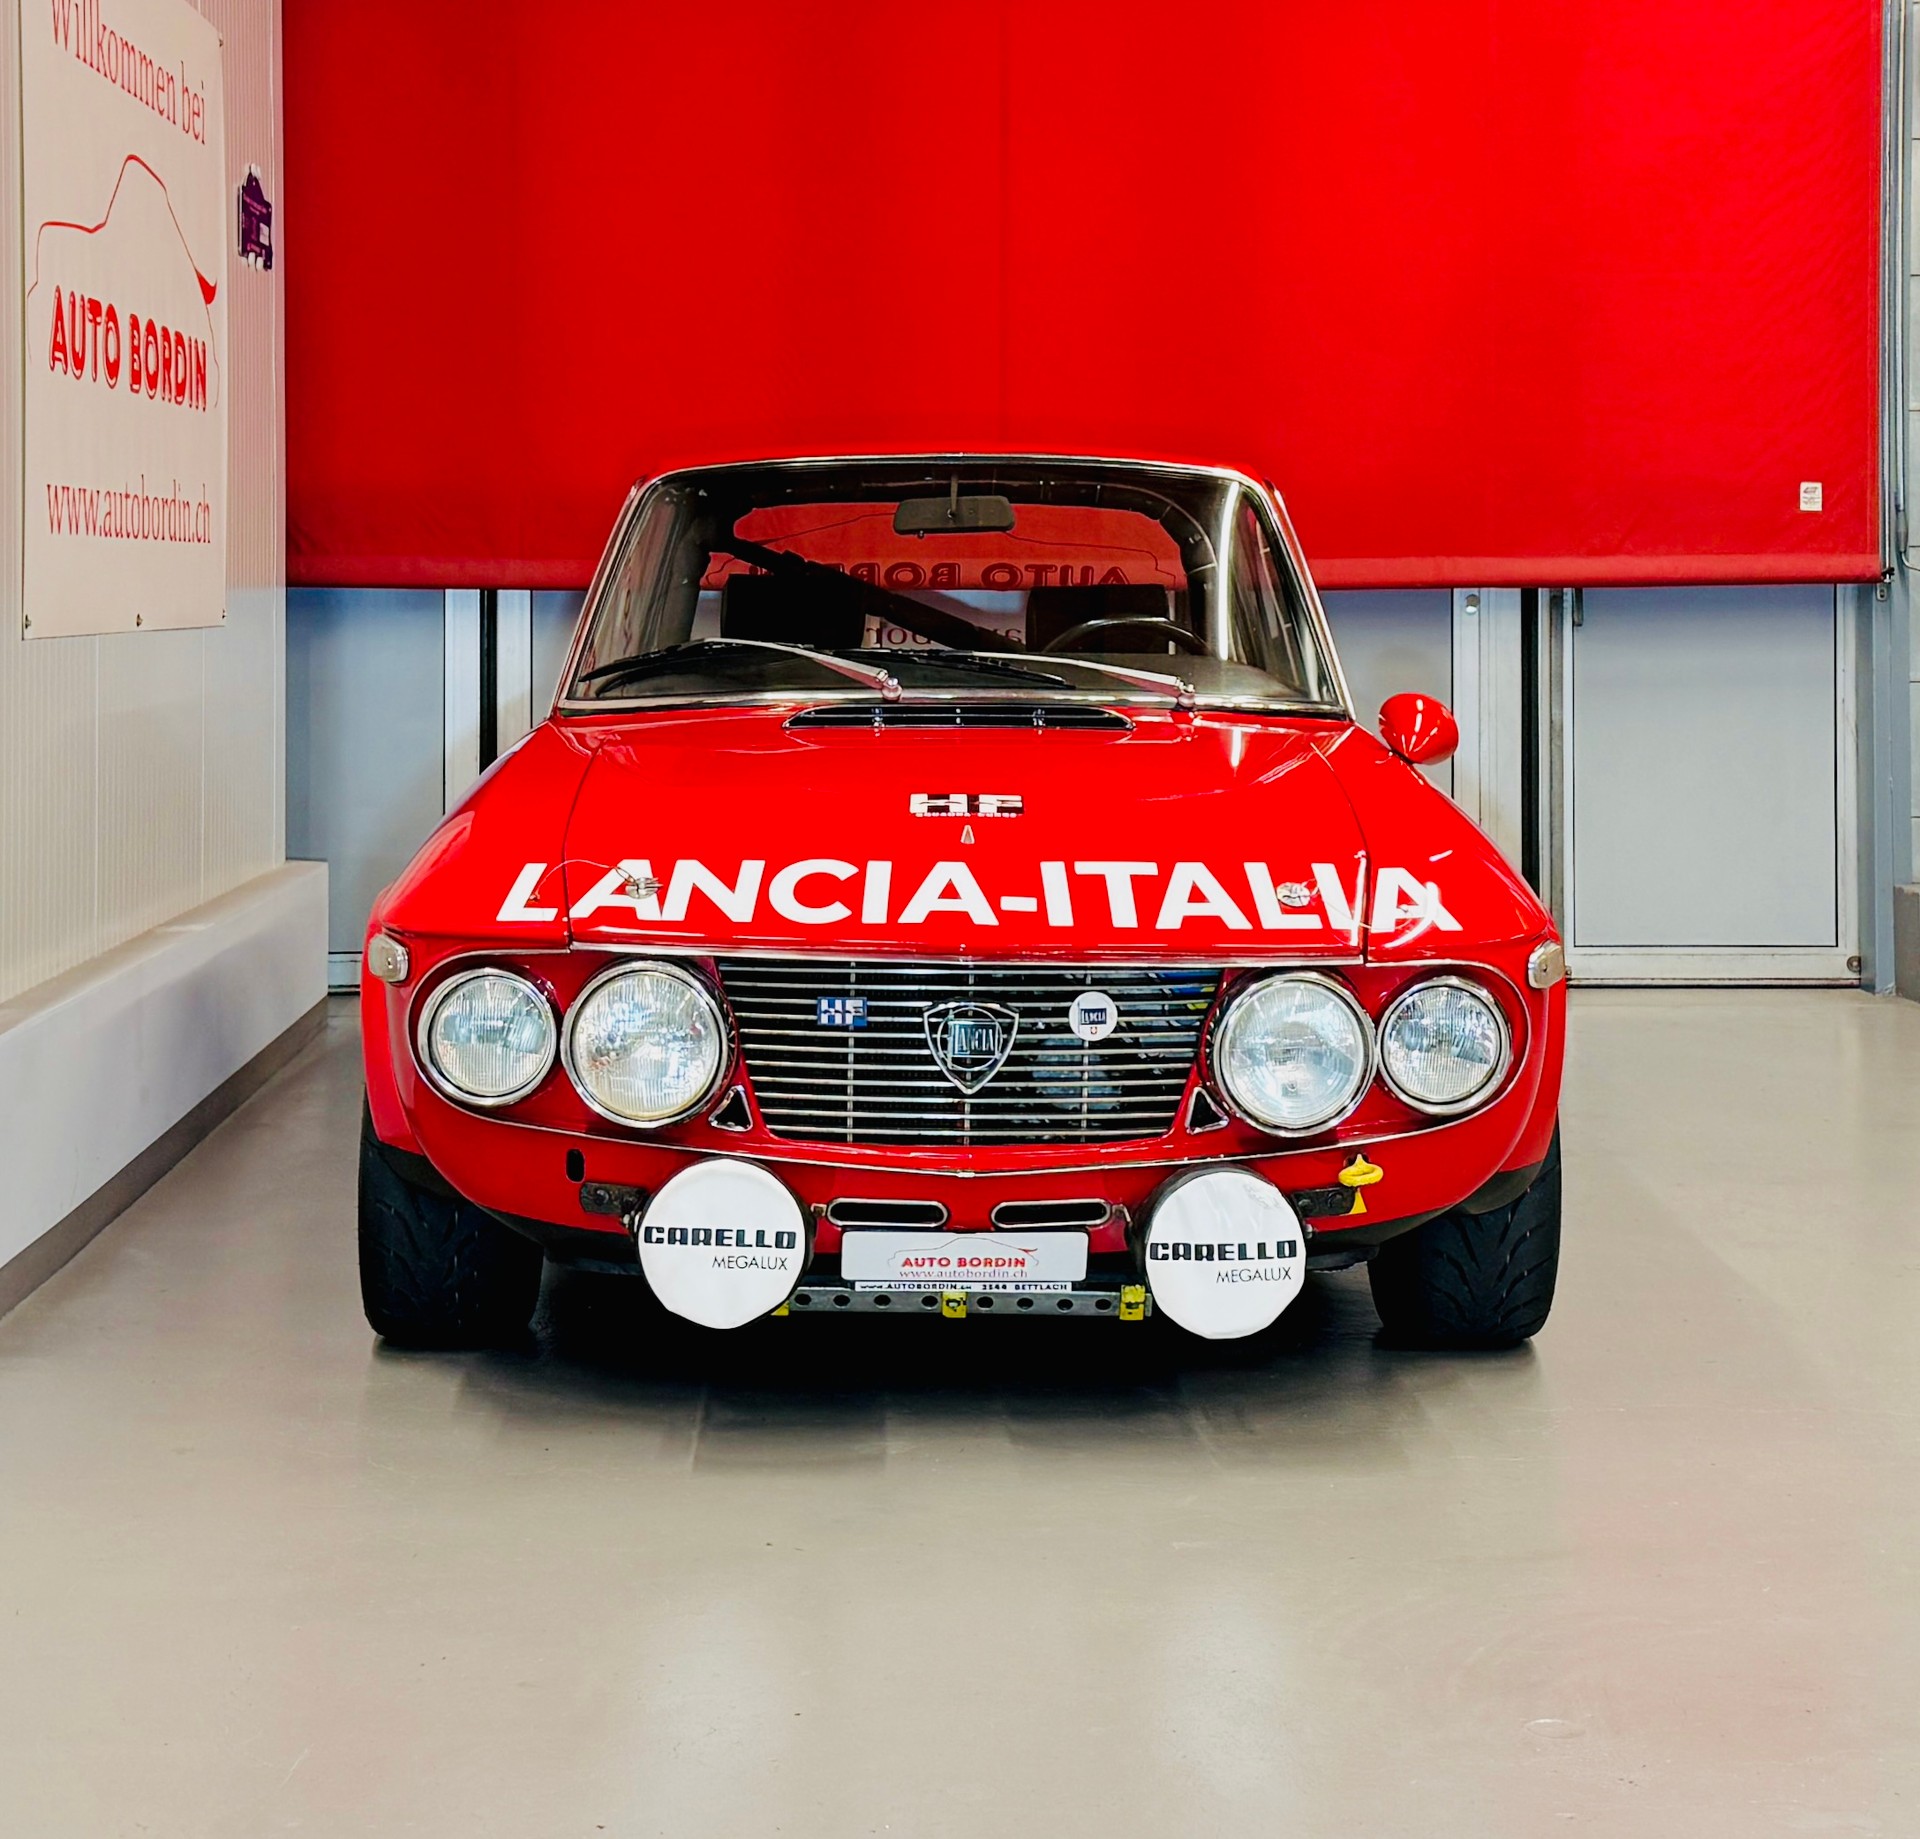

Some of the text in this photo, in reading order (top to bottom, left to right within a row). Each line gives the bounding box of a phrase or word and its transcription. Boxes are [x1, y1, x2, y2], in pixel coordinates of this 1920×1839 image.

[180, 60, 205, 145] bei
[49, 284, 207, 413] AUTO BORDIN
[46, 473, 212, 544] www.autobordin.ch
[909, 793, 1024, 814] HF
[495, 858, 1464, 932] LANCIA-ITALIA
[954, 1023, 995, 1054] LANCIA
[643, 1226, 797, 1249] CARELLO
[1149, 1240, 1297, 1262] CARELLO
[712, 1255, 789, 1271] MEGALUX
[901, 1257, 1026, 1268] AUTO BORDIN
[899, 1269, 1028, 1279] www.autobordin.ch
[1216, 1266, 1292, 1284] MEGALUX
